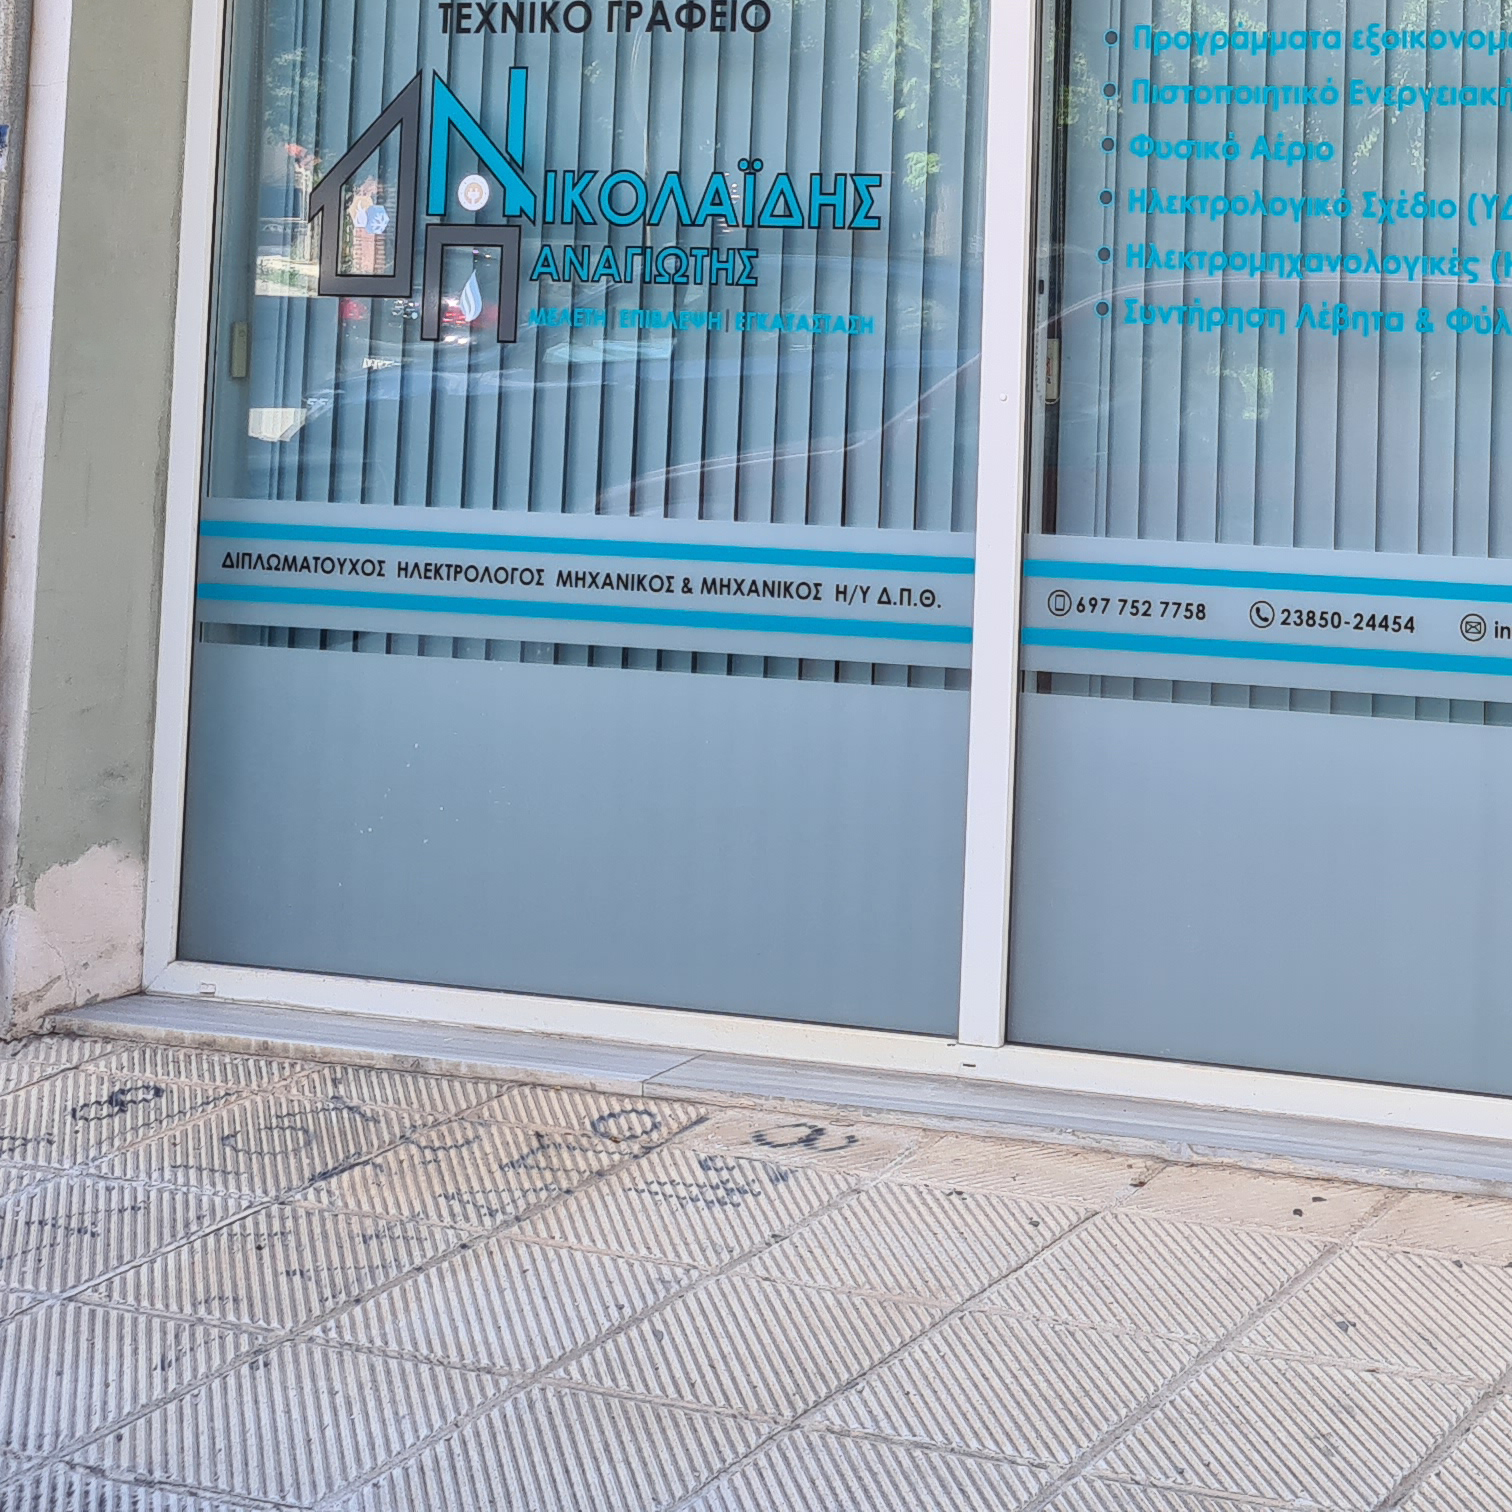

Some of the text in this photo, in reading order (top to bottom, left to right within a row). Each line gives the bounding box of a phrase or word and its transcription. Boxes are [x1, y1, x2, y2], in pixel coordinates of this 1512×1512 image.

[439, 1, 593, 35] ΤΕΧΝΙΚΟ
[1133, 22, 1342, 56] Προγράμματα
[1131, 77, 1340, 112] Πιστοποιητικό
[1129, 131, 1335, 167] Φυσικό Αέριο
[1128, 188, 1353, 223] Ηλεκτρολογικό
[1361, 189, 1458, 225] Σχέδιο
[1126, 243, 1481, 284] Ηλεκτρομηχανολογικές
[528, 306, 876, 337] ΜΕΛΕΤΗ ΕΠΙΒΛΕΨΗ ΕΓΚΑΤΑΣΤΑΣΗ
[1123, 297, 1287, 335] Συντήρηση
[1295, 301, 1405, 338] Λέβητα
[1415, 307, 1436, 335] &
[221, 551, 942, 609] ΔΙΠΛΩΜΑΤΟΥΧΟΣ ΗΛΕΚΤΡΟΛΟΓΟΣ ΜΗΧΑΝΙΚΟΣ & ΜΗΧΑΝΙΚΟΣ Η/Υ Δ.Π.Θ.
[1075, 594, 1206, 621] 697 752 7758
[1280, 608, 1415, 634] 23850-24454
